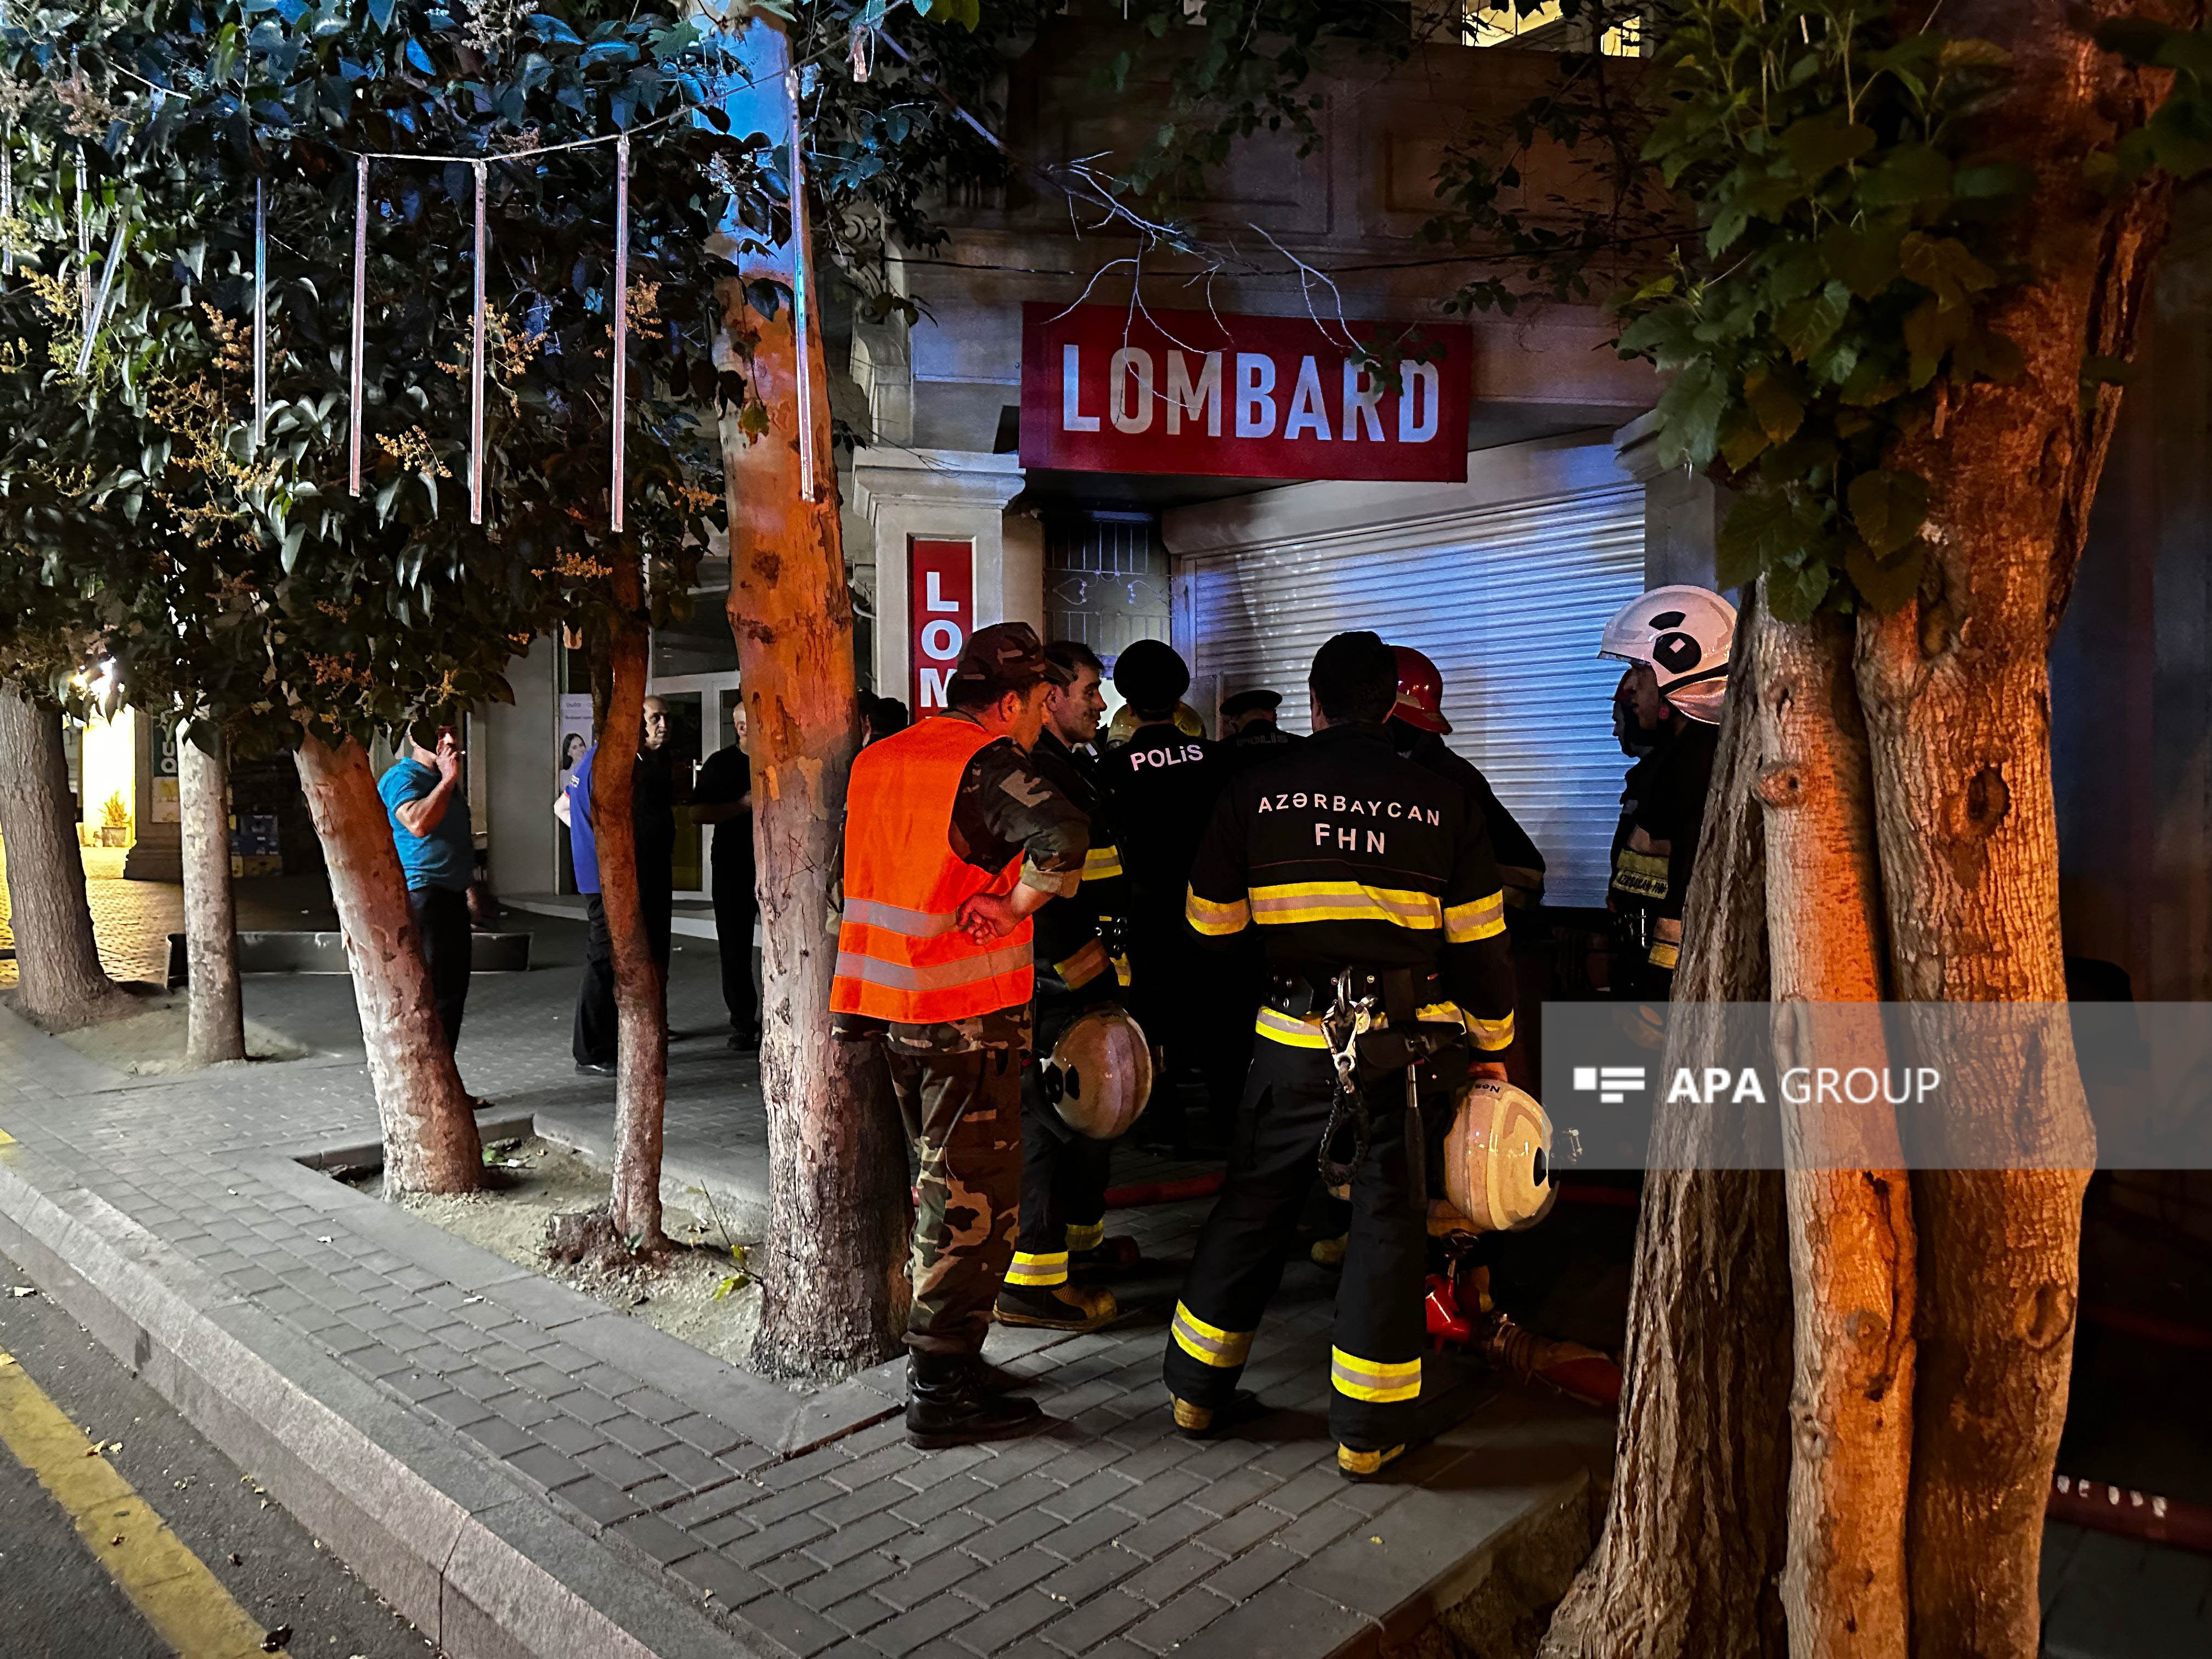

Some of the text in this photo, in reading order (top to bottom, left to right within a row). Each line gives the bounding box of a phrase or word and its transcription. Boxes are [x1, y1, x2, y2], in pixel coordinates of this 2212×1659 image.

[1063, 344, 1438, 443] LOMBARD
[1258, 793, 1440, 827] AZƏRBAYCAN
[1314, 823, 1385, 854] FHN
